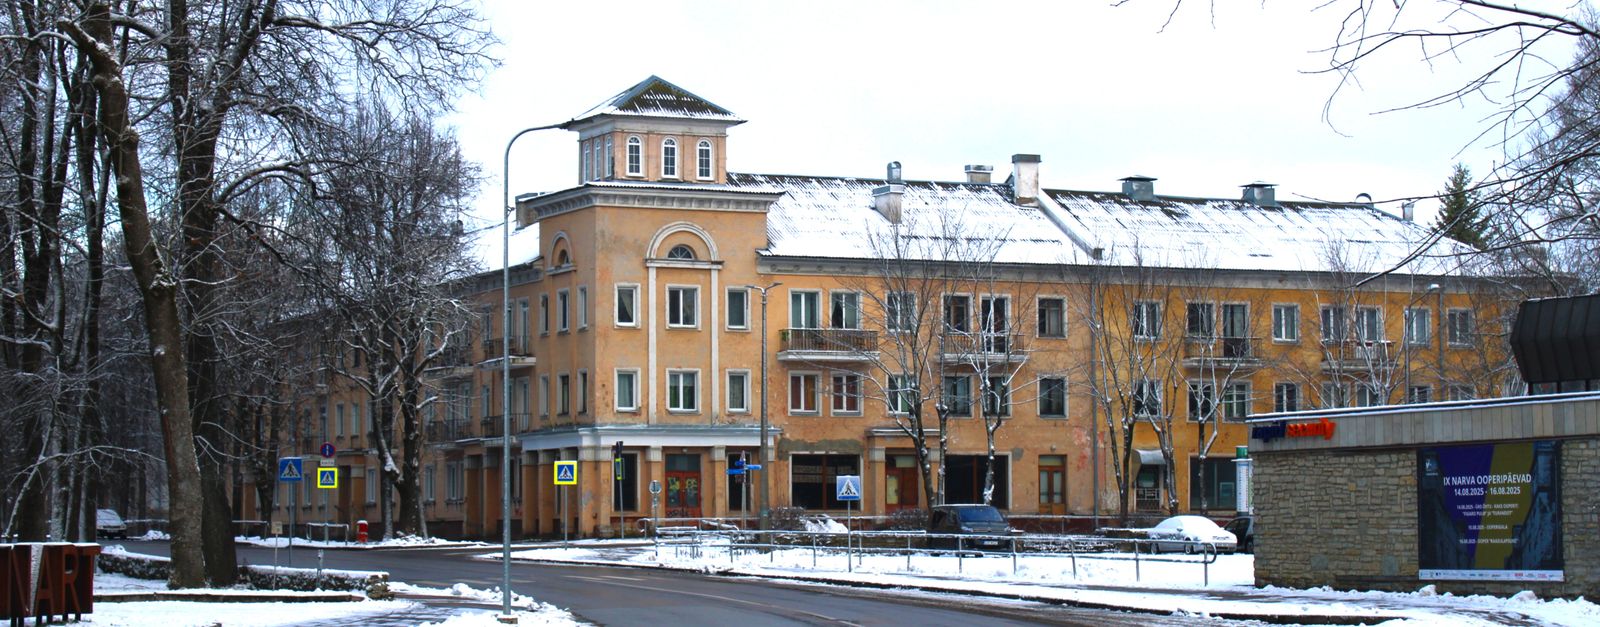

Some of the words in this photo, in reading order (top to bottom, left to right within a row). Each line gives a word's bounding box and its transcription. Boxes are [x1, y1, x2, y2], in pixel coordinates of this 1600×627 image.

[1287, 417, 1336, 440] security
[1443, 476, 1451, 486] IX
[1451, 475, 1476, 486] NARVA
[1476, 472, 1532, 485] OOPERIPÄEVAD
[1454, 487, 1484, 496] 14.08.2025
[1490, 486, 1521, 495] 16.08.2025
[4, 544, 101, 618] NART
